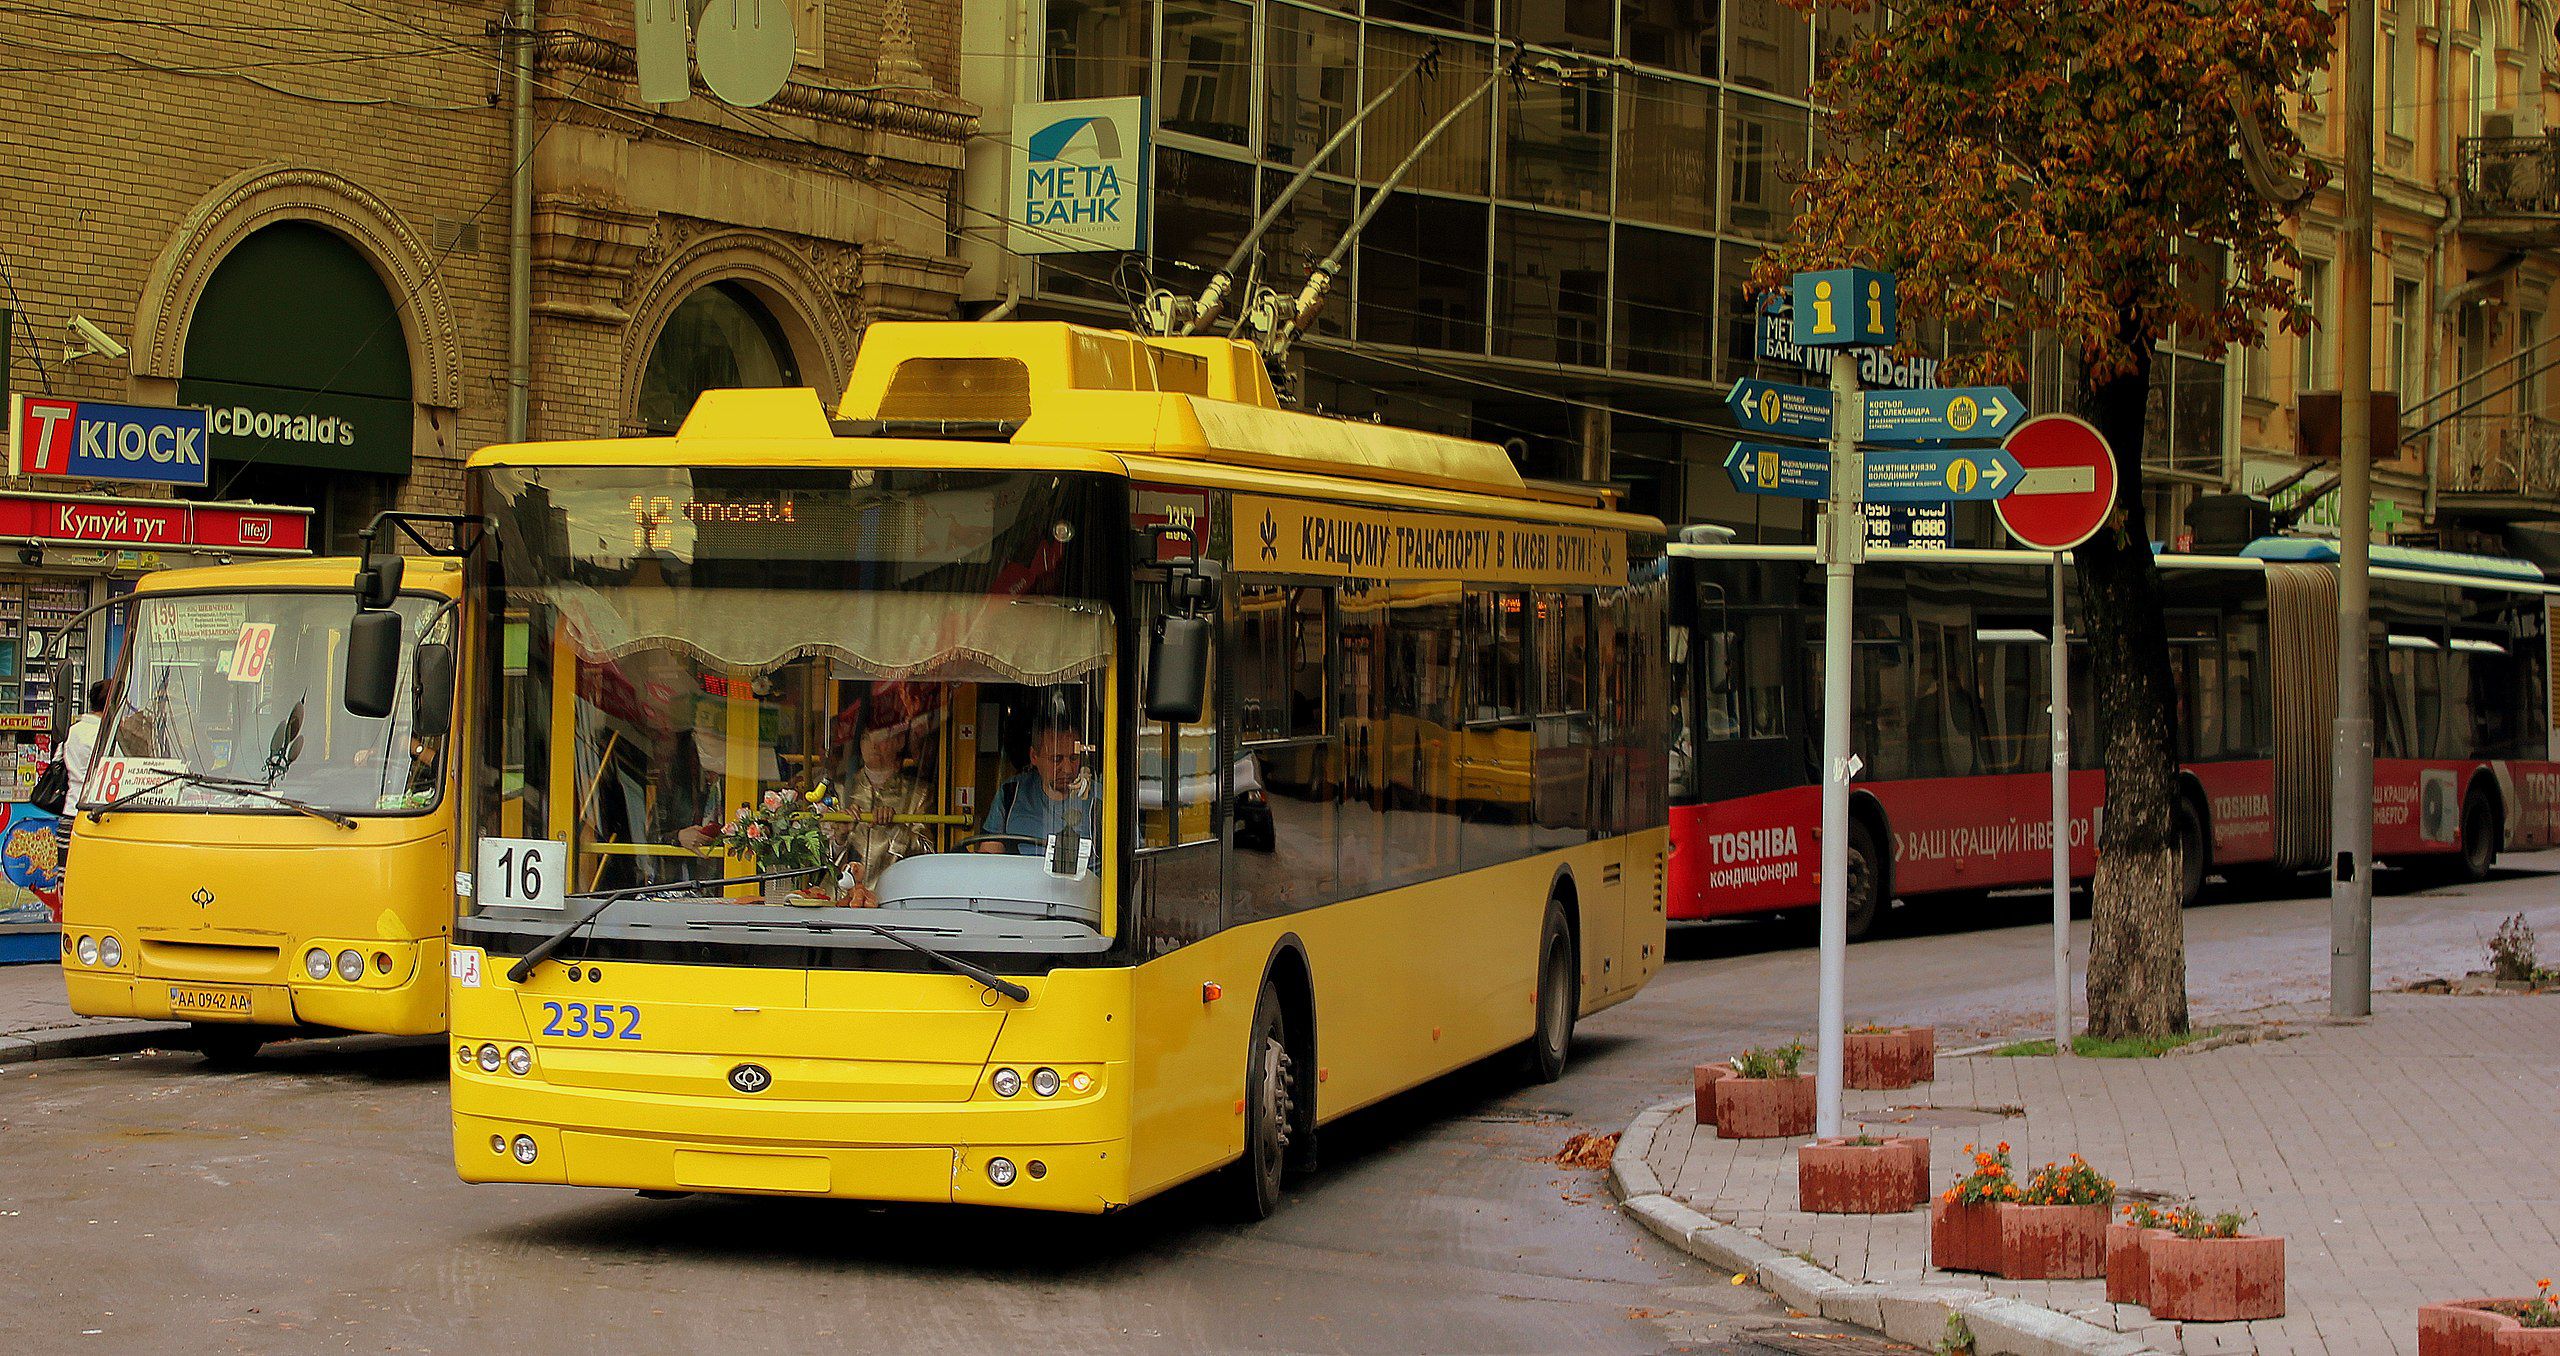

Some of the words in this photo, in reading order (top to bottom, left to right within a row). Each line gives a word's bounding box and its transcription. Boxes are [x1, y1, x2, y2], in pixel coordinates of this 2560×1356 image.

[1027, 165, 1121, 199] МЕТА
[1026, 197, 1120, 225] БАНК
[1766, 315, 1795, 342] МЕТ
[1766, 338, 1802, 363] БАНК
[60, 505, 127, 540] Купуй
[134, 517, 166, 543] тут
[1301, 515, 1390, 573] КРАЩОМУ
[1396, 527, 1490, 570] ТРАНСПОРТУ
[1496, 533, 1504, 568] В
[1512, 531, 1549, 571] КИЄВІ
[1556, 536, 1591, 573] БУТИ!
[238, 627, 271, 677] 18
[93, 761, 125, 803] 18
[2215, 795, 2269, 819] TOSHIBA
[1709, 826, 1798, 865] TOSHIBA
[1909, 829, 1946, 861] ВАШ
[1950, 817, 2019, 860] КРАЩИЙ
[498, 847, 542, 900] 16
[1710, 859, 1798, 889] кондиціонери
[199, 993, 226, 1008] 0942
[542, 1001, 642, 1040] 2352
